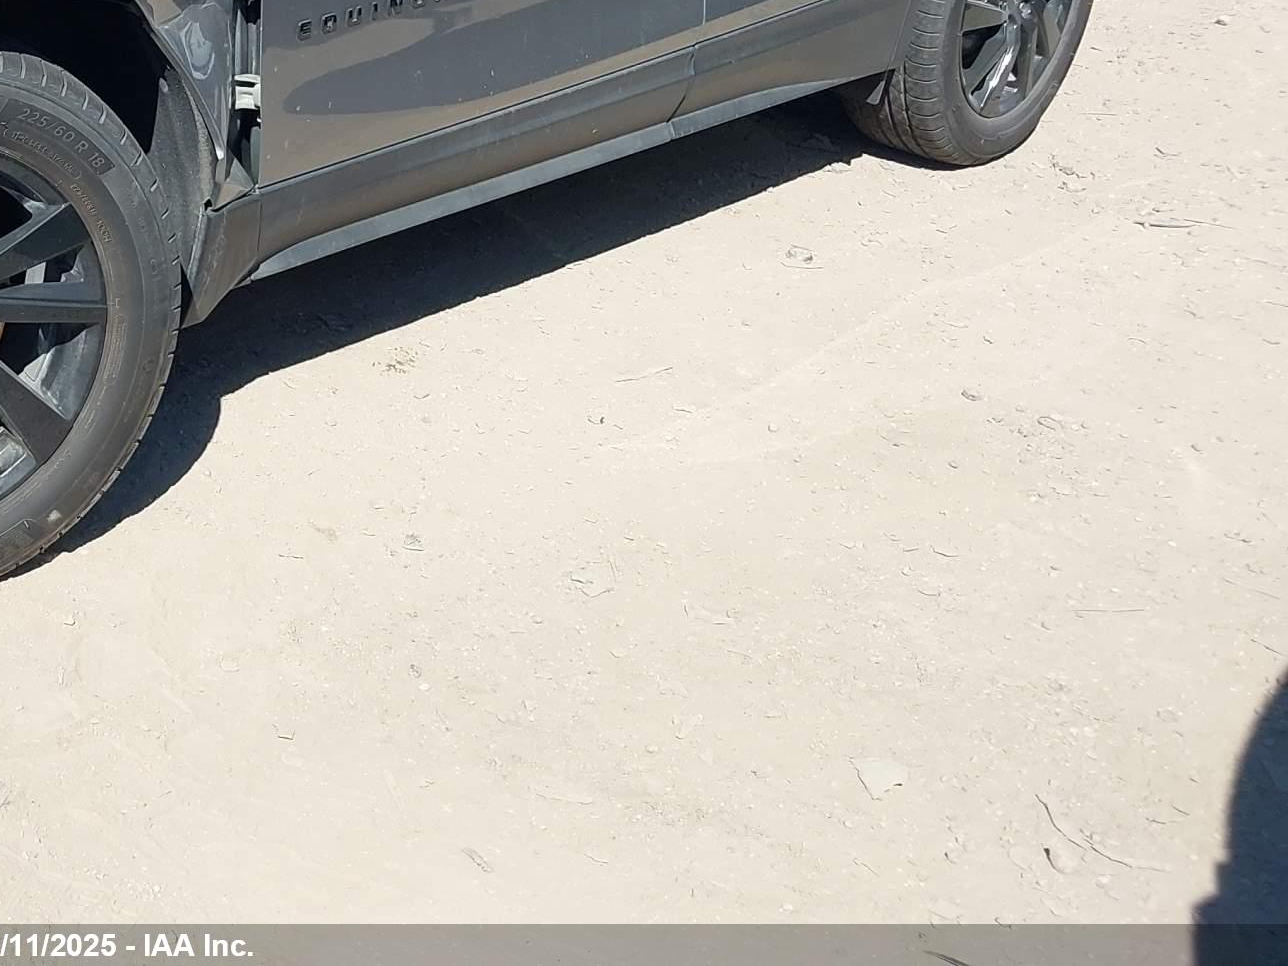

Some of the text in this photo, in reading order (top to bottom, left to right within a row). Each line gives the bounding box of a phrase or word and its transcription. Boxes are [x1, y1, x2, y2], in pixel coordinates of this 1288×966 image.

[16, 107, 106, 169] 225/60 R 18
